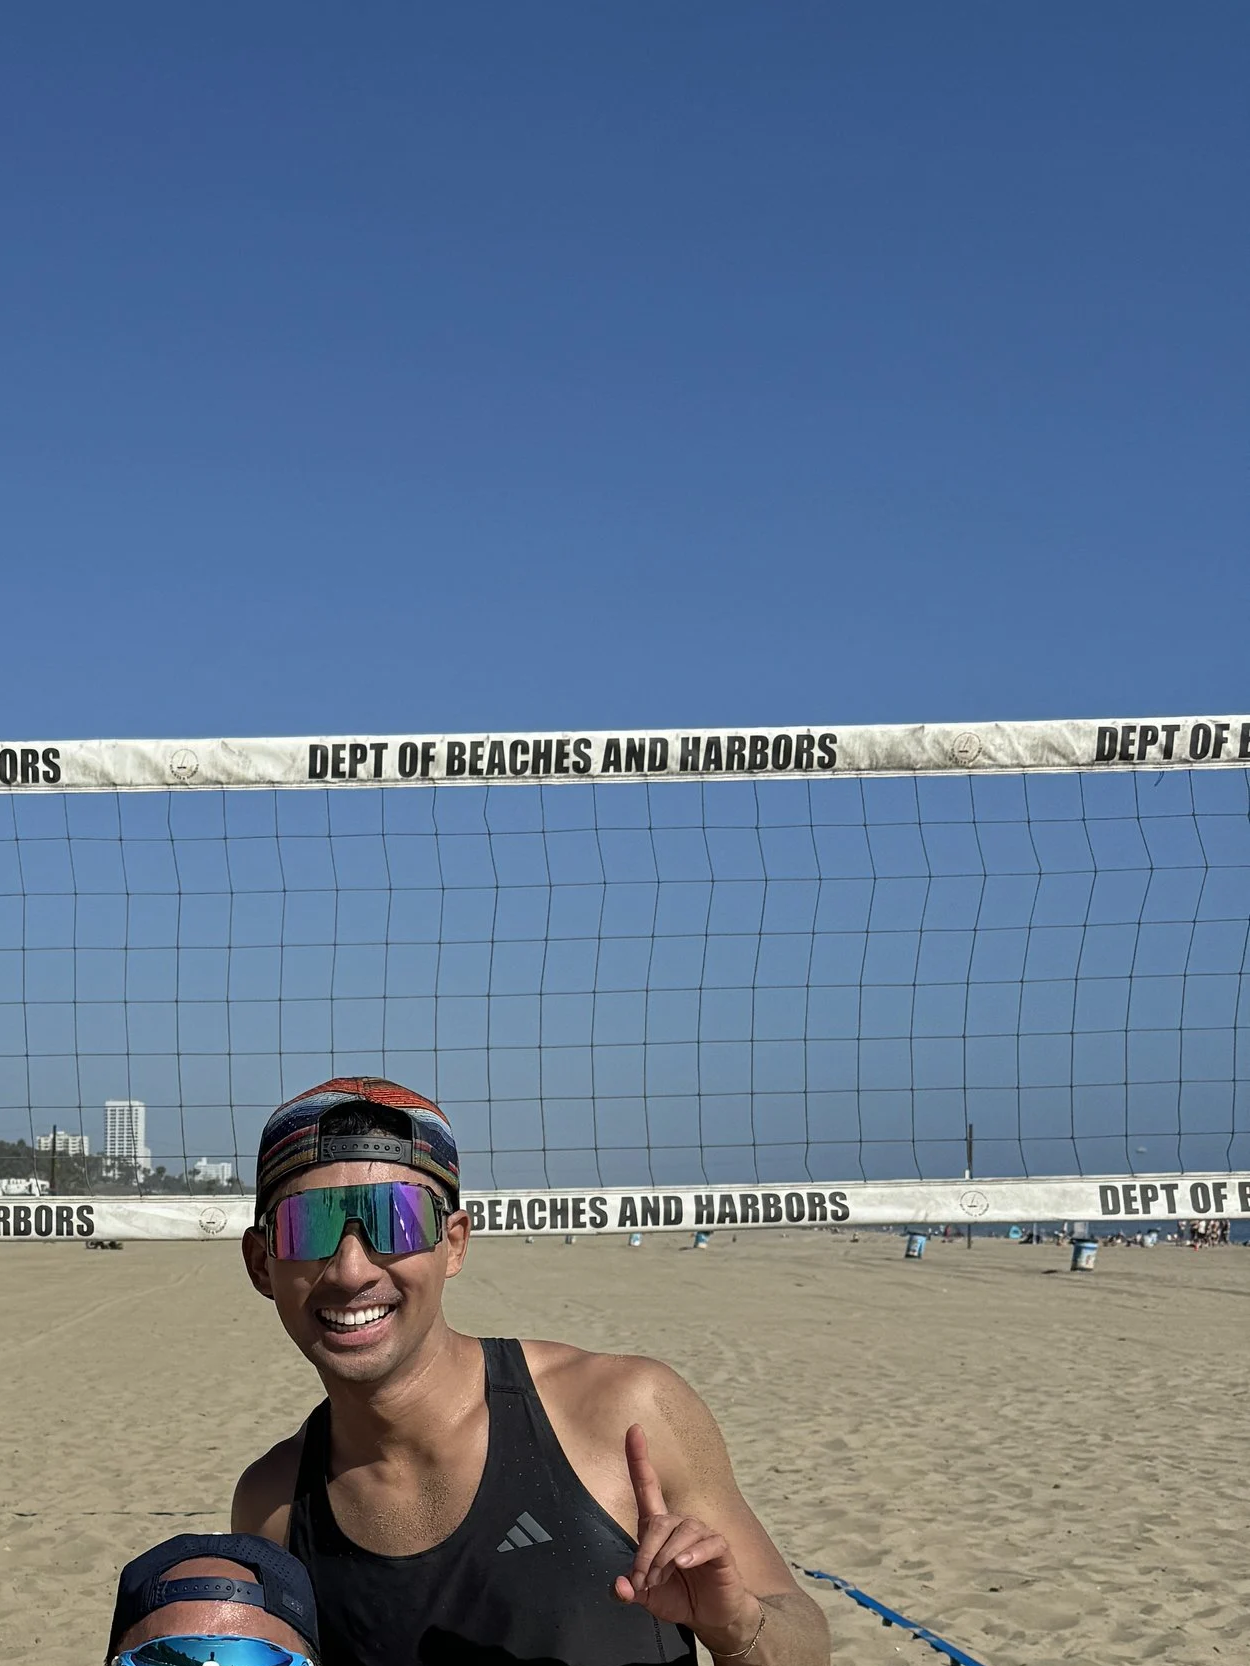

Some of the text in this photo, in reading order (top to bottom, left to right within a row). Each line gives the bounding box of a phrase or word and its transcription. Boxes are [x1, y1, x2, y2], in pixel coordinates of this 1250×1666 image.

[308, 733, 837, 780] DEPT OF BEACHES AND HARBORS
[1095, 724, 1180, 762] DEPT
[1190, 722, 1230, 760] OF
[466, 1191, 851, 1232] BEACHES AND HARBORS
[1099, 1183, 1179, 1216] DEPT
[1189, 1181, 1228, 1214] OF
